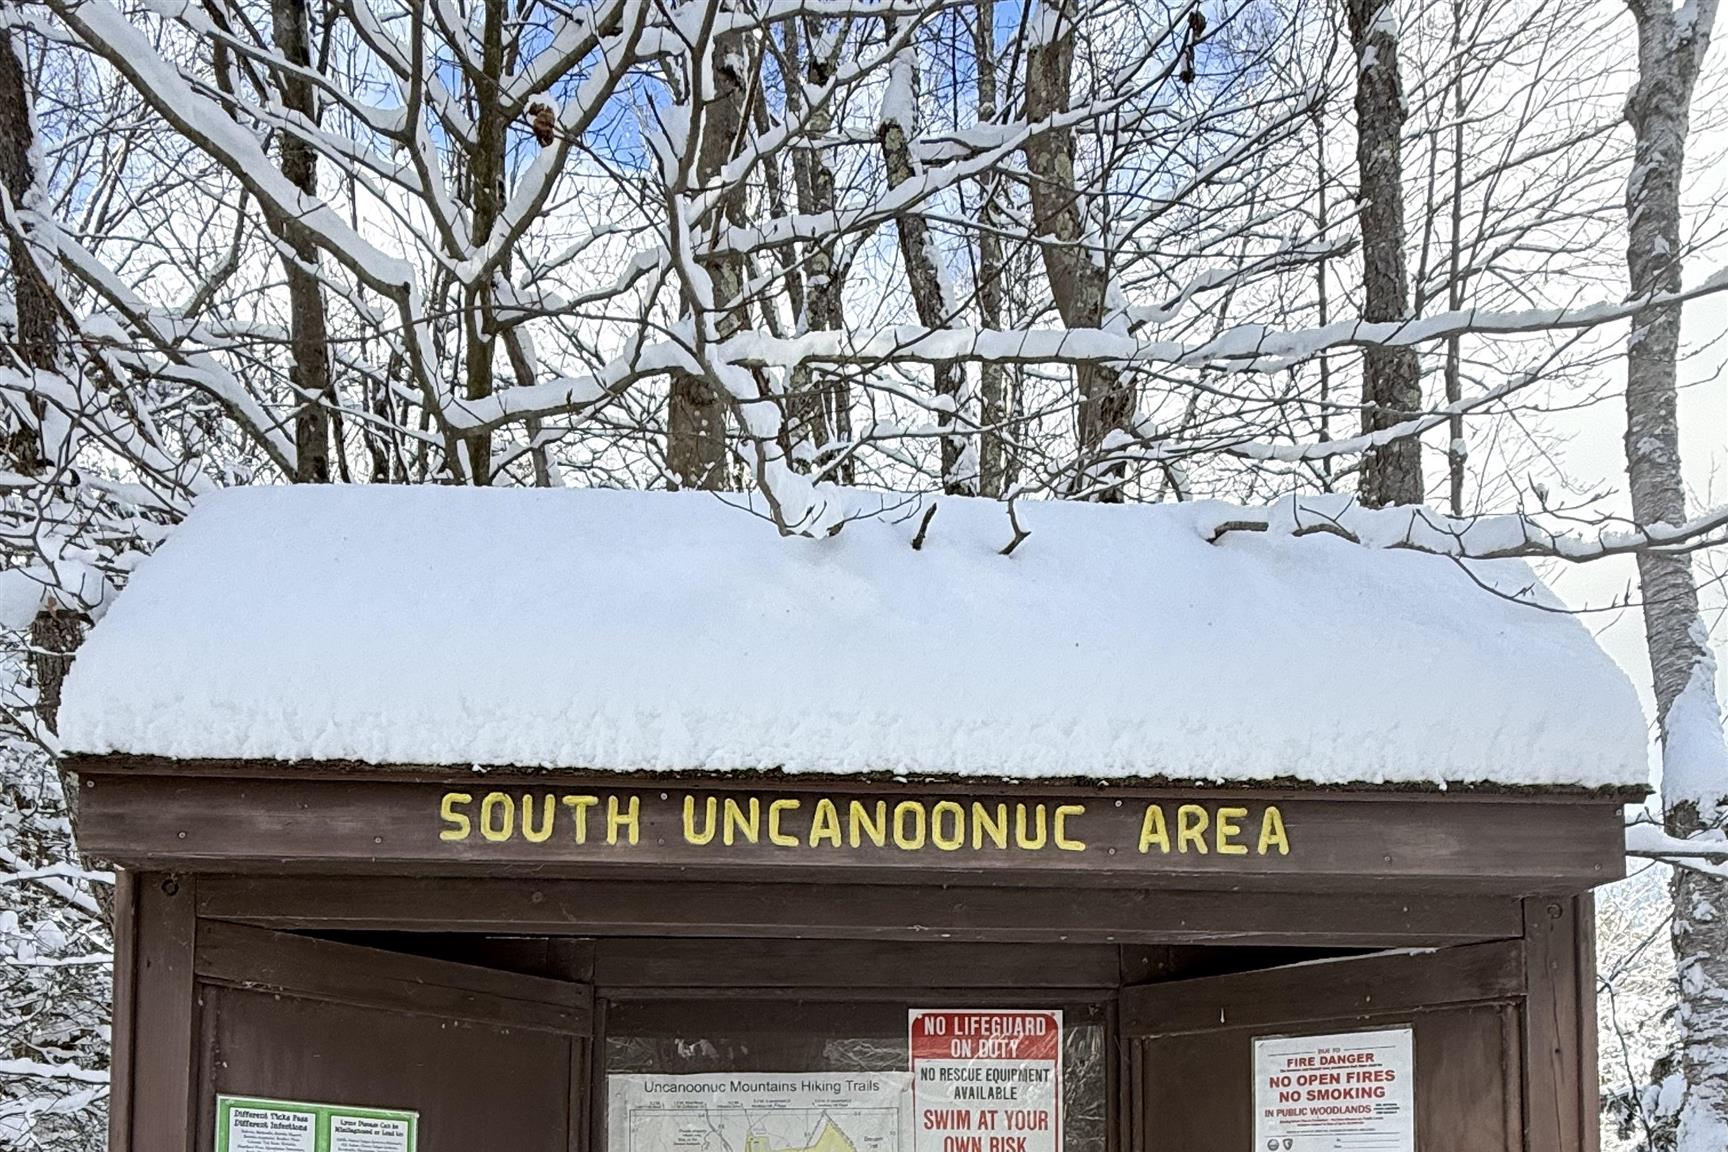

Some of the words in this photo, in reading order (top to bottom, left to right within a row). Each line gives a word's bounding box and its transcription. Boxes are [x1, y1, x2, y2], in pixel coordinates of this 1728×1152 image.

[439, 792, 640, 846] SOUTH
[683, 795, 1086, 850] UNCANOONUC
[1139, 804, 1290, 856] AREA
[924, 1016, 946, 1036] NO
[954, 1016, 1046, 1036] LIFEGUARD
[951, 1039, 972, 1058] ON
[979, 1039, 1020, 1058] DUTY
[1287, 1057, 1316, 1068] FIRE
[1320, 1053, 1375, 1065] DANGER
[920, 1067, 936, 1081] NO
[940, 1067, 982, 1082] RESCUE
[986, 1068, 1050, 1083] EQUIPMENT
[1269, 1076, 1291, 1088] NO
[1297, 1073, 1340, 1086] OPEN
[1346, 1070, 1395, 1083] FIRES
[644, 1081, 726, 1093] Uncanoonuc
[730, 1080, 797, 1092] Mountains
[801, 1080, 841, 1094] Hiking
[846, 1080, 880, 1091] Trails
[954, 1086, 1018, 1100] AVAILABLE
[1279, 1091, 1301, 1103] NO
[1306, 1086, 1385, 1101] SMOKING
[234, 1109, 268, 1119] Different
[270, 1112, 290, 1121] Ticks
[293, 1114, 308, 1122] Pass
[1265, 1109, 1274, 1117] IN
[1276, 1108, 1308, 1117] PUBLIC
[1310, 1105, 1372, 1116] WOODLANDS
[234, 1119, 268, 1128] Different
[270, 1122, 308, 1131] Infections
[923, 1109, 971, 1130] SWIM
[978, 1110, 998, 1130] AT
[1004, 1110, 1049, 1131] YOUR
